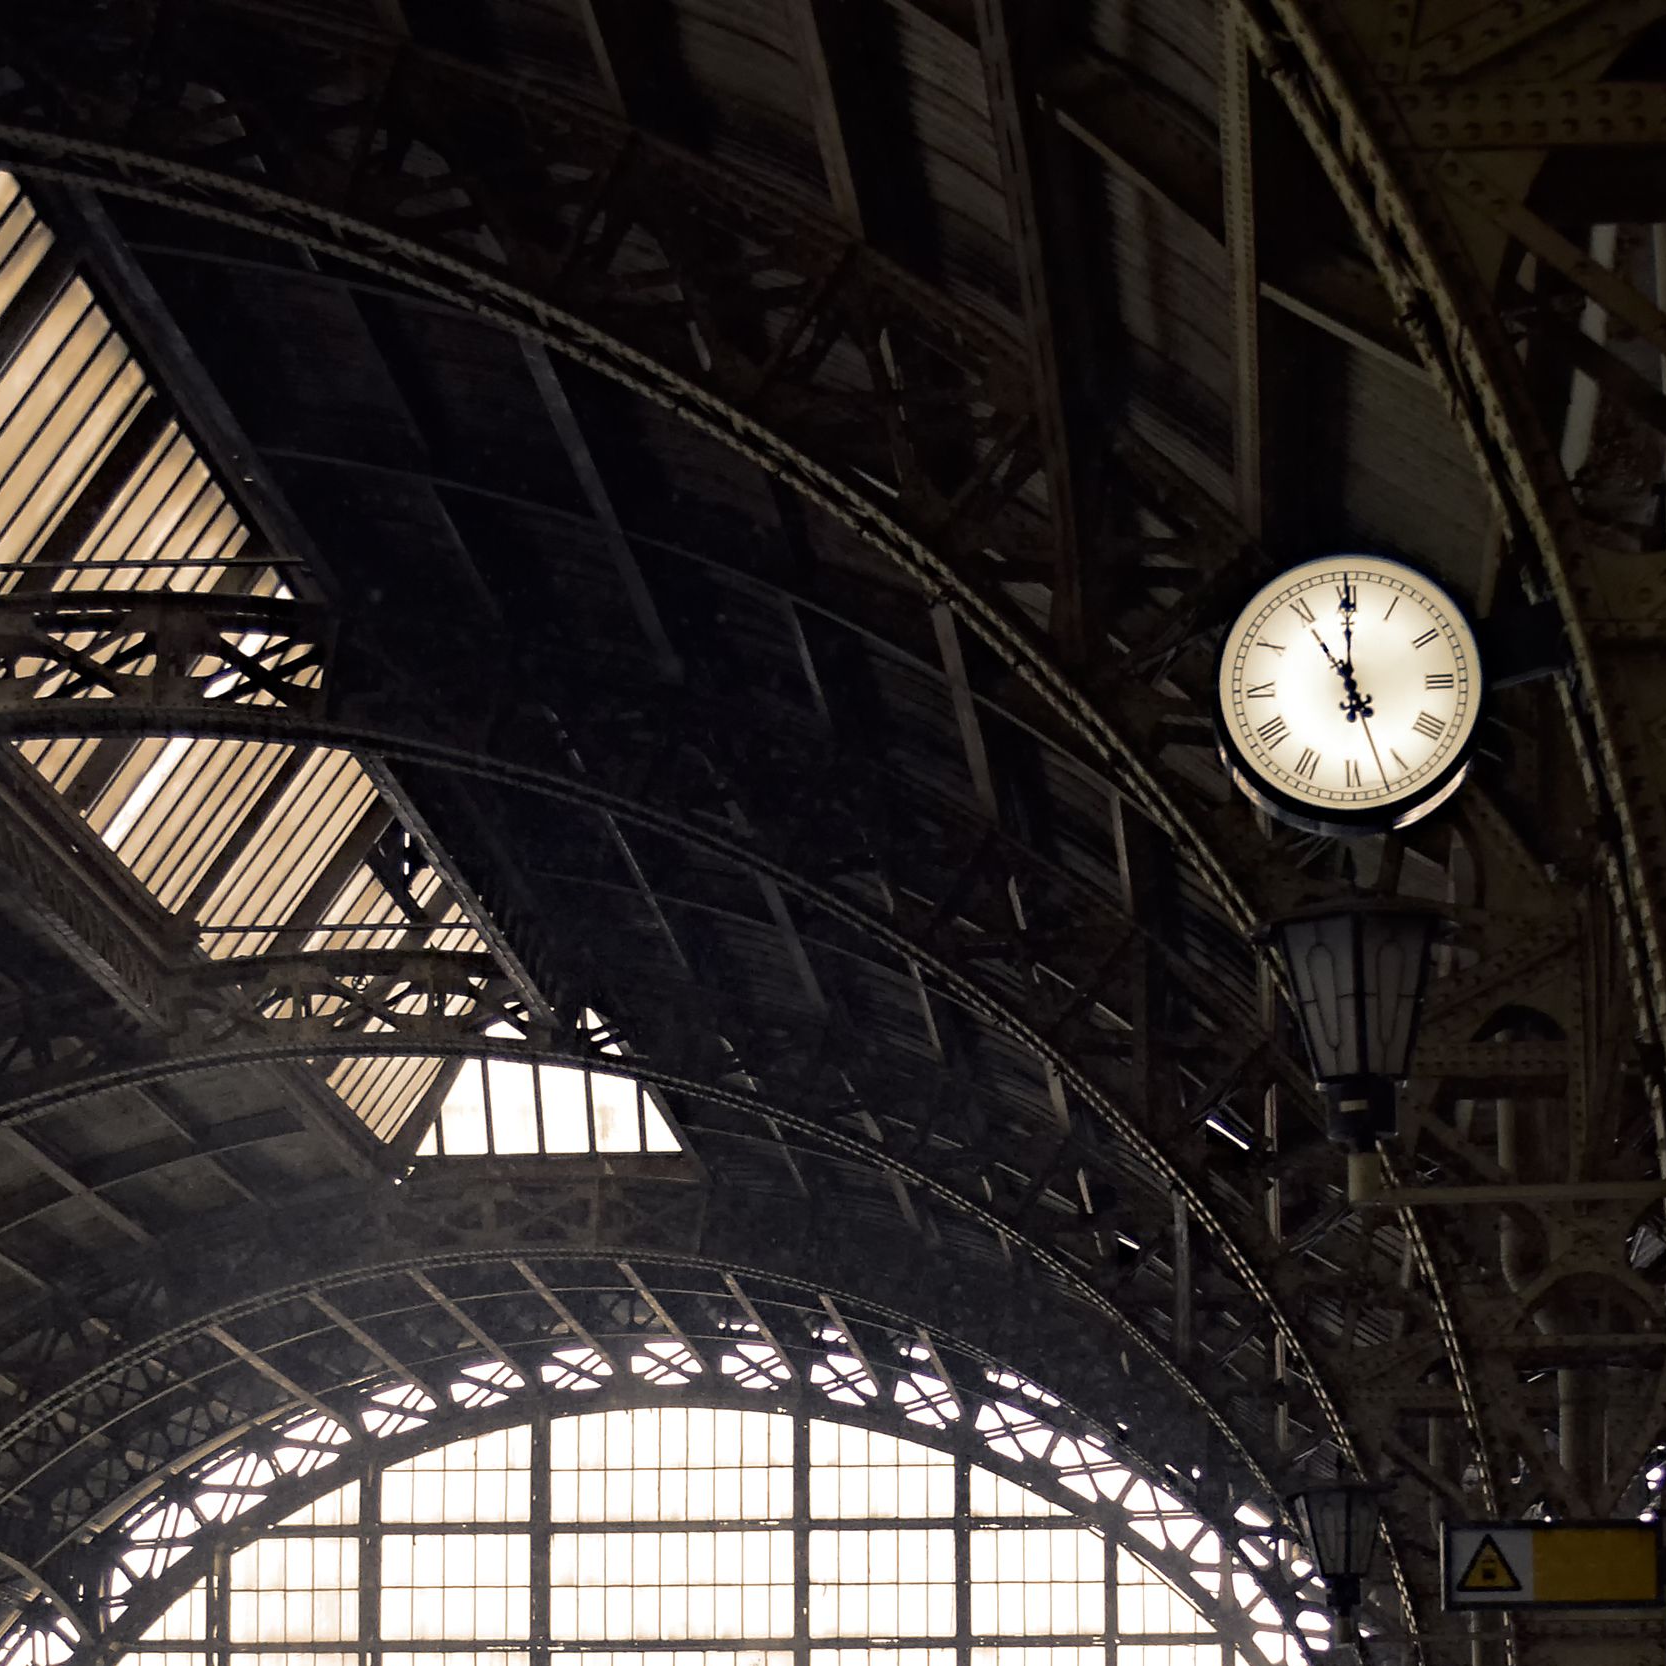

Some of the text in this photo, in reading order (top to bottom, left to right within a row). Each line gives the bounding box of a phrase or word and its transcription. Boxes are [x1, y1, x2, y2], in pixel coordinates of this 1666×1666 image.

[1289, 597, 1316, 626] XI
[1413, 628, 1439, 649] II
[1247, 681, 1275, 698] IX
[1425, 673, 1454, 690] III
[1257, 716, 1291, 750] VIII
[1413, 712, 1446, 740] IIII
[1294, 748, 1321, 780] VII
[1345, 759, 1361, 788] VI
